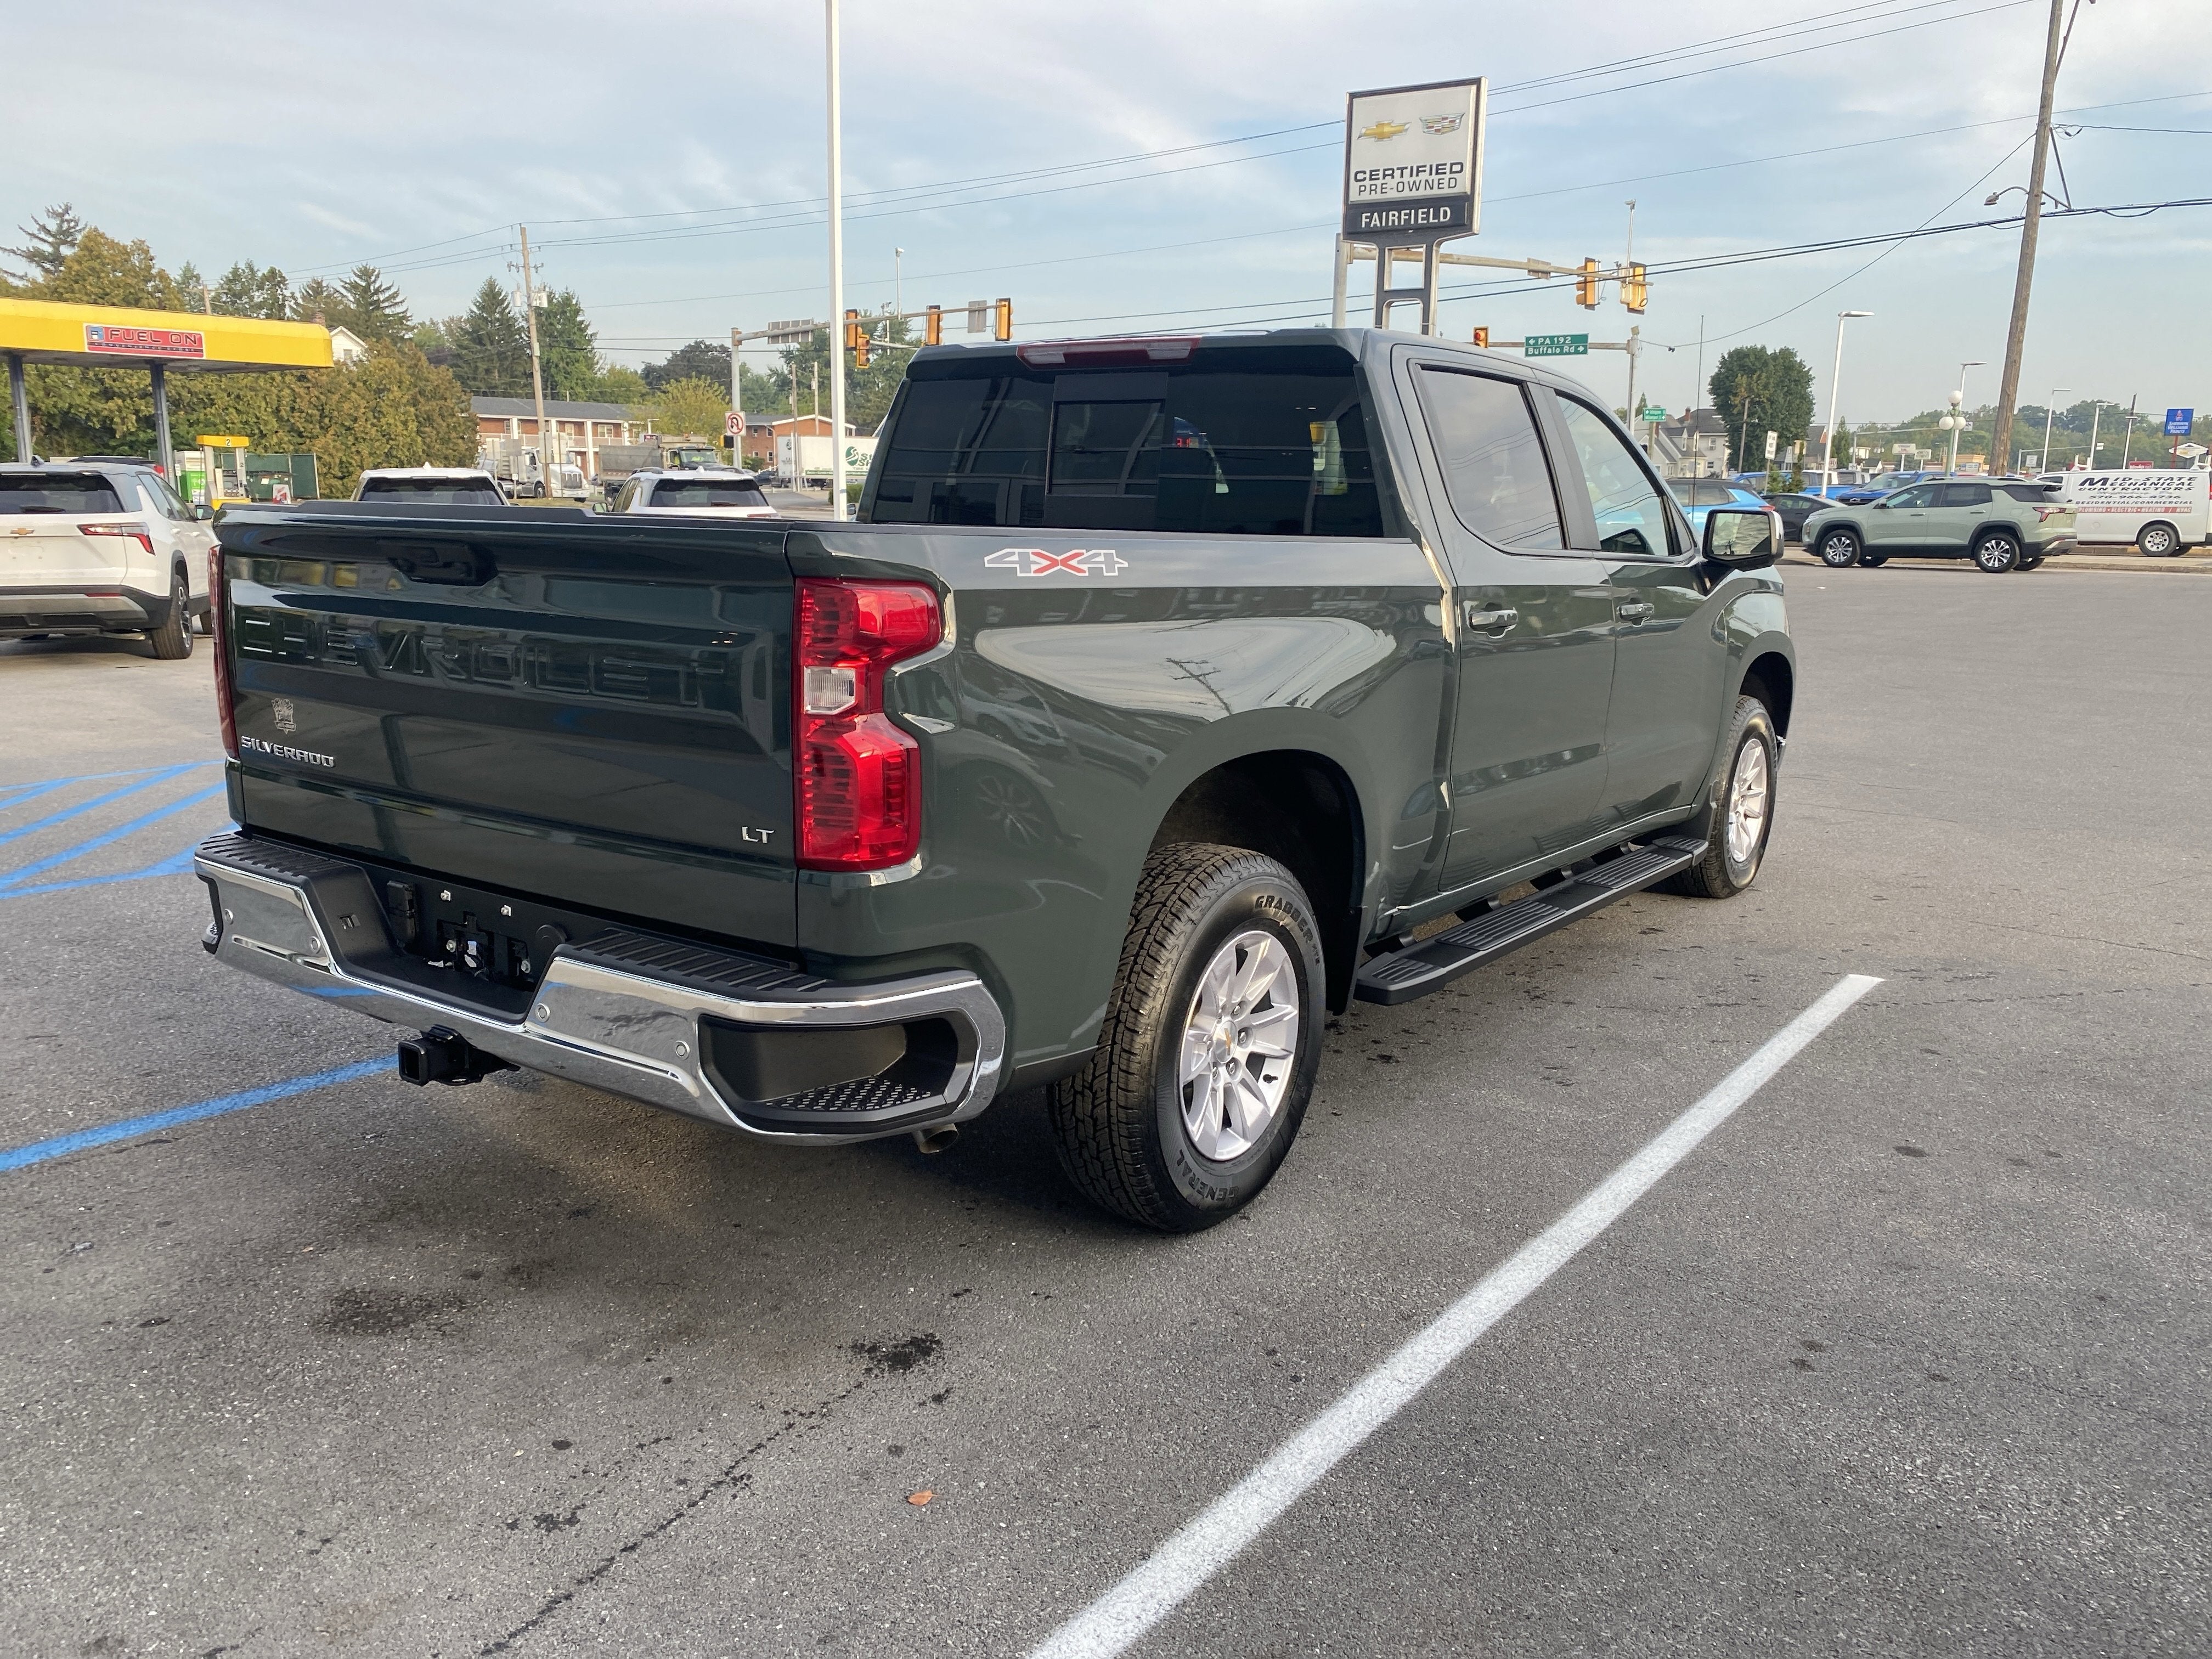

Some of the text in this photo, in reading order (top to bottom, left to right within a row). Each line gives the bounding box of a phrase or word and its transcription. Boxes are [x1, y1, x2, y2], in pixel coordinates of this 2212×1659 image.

[1354, 162, 1464, 182] CERTIFIED
[1358, 177, 1457, 196] PRE-OWNED
[1361, 207, 1451, 228] FAIRFIELD
[109, 329, 198, 346] FUEL ON
[1528, 346, 1560, 354] Buffalo
[226, 438, 230, 447] 2
[2078, 477, 2198, 486] MID-STATE
[239, 613, 727, 708] CHEVROLET
[241, 736, 335, 768] SILVERADO
[742, 826, 775, 844] LT
[1254, 895, 1314, 944] GRABBER
[1176, 1149, 1239, 1201] GENERAL
